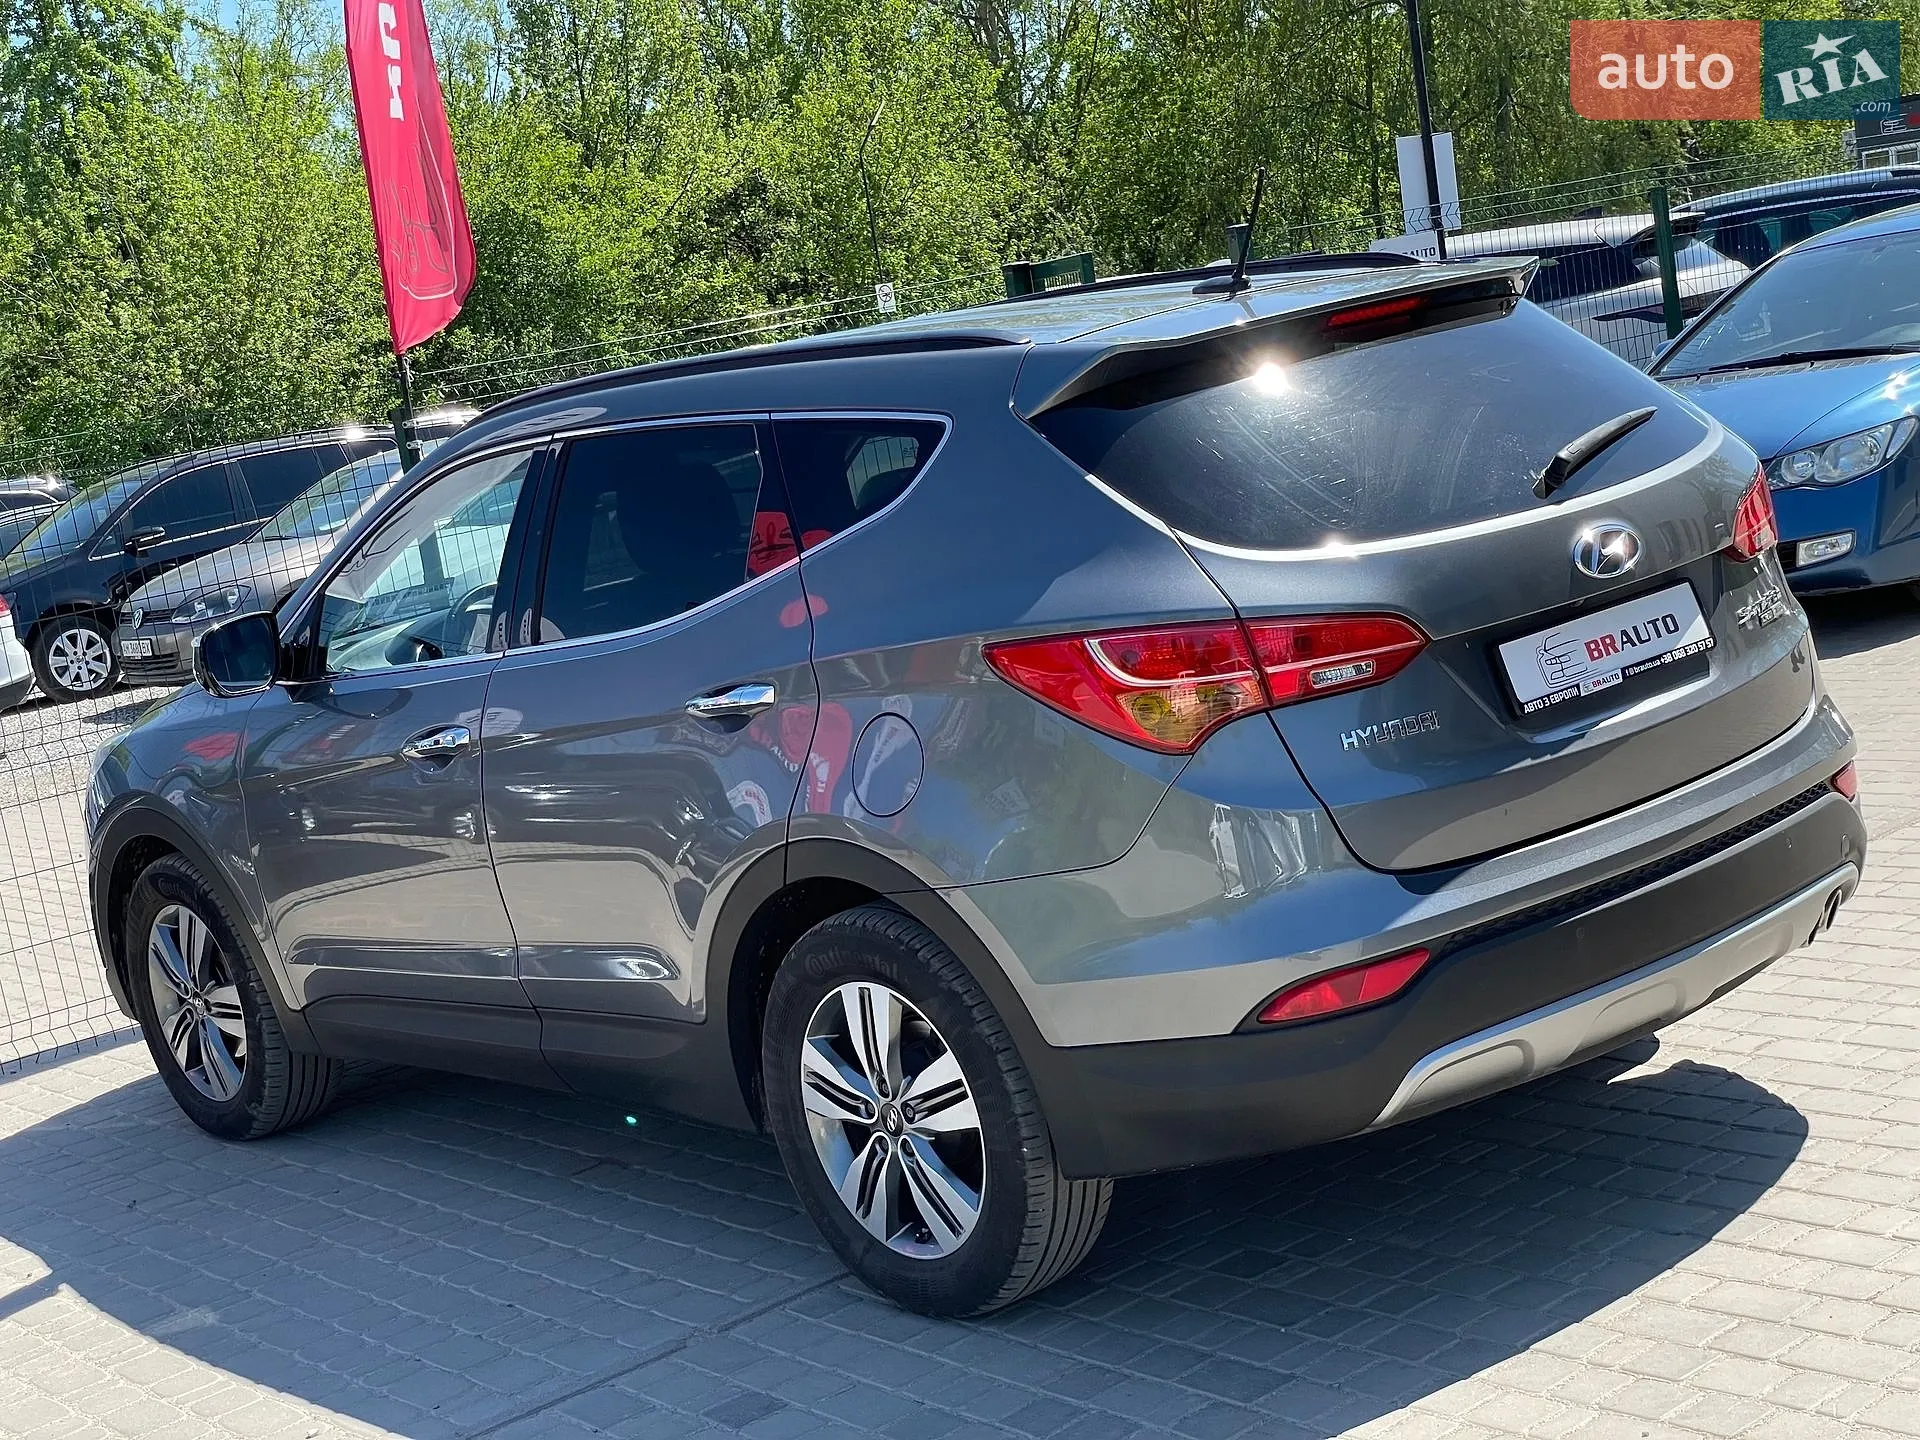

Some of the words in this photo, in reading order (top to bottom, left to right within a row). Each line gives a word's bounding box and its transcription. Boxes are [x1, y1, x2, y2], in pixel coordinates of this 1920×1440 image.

[1584, 613, 1680, 662] BRAUTO
[1591, 672, 1620, 688] BRAUTO
[1523, 699, 1544, 714] АВТО
[1340, 710, 1440, 751] HYUNDAI
